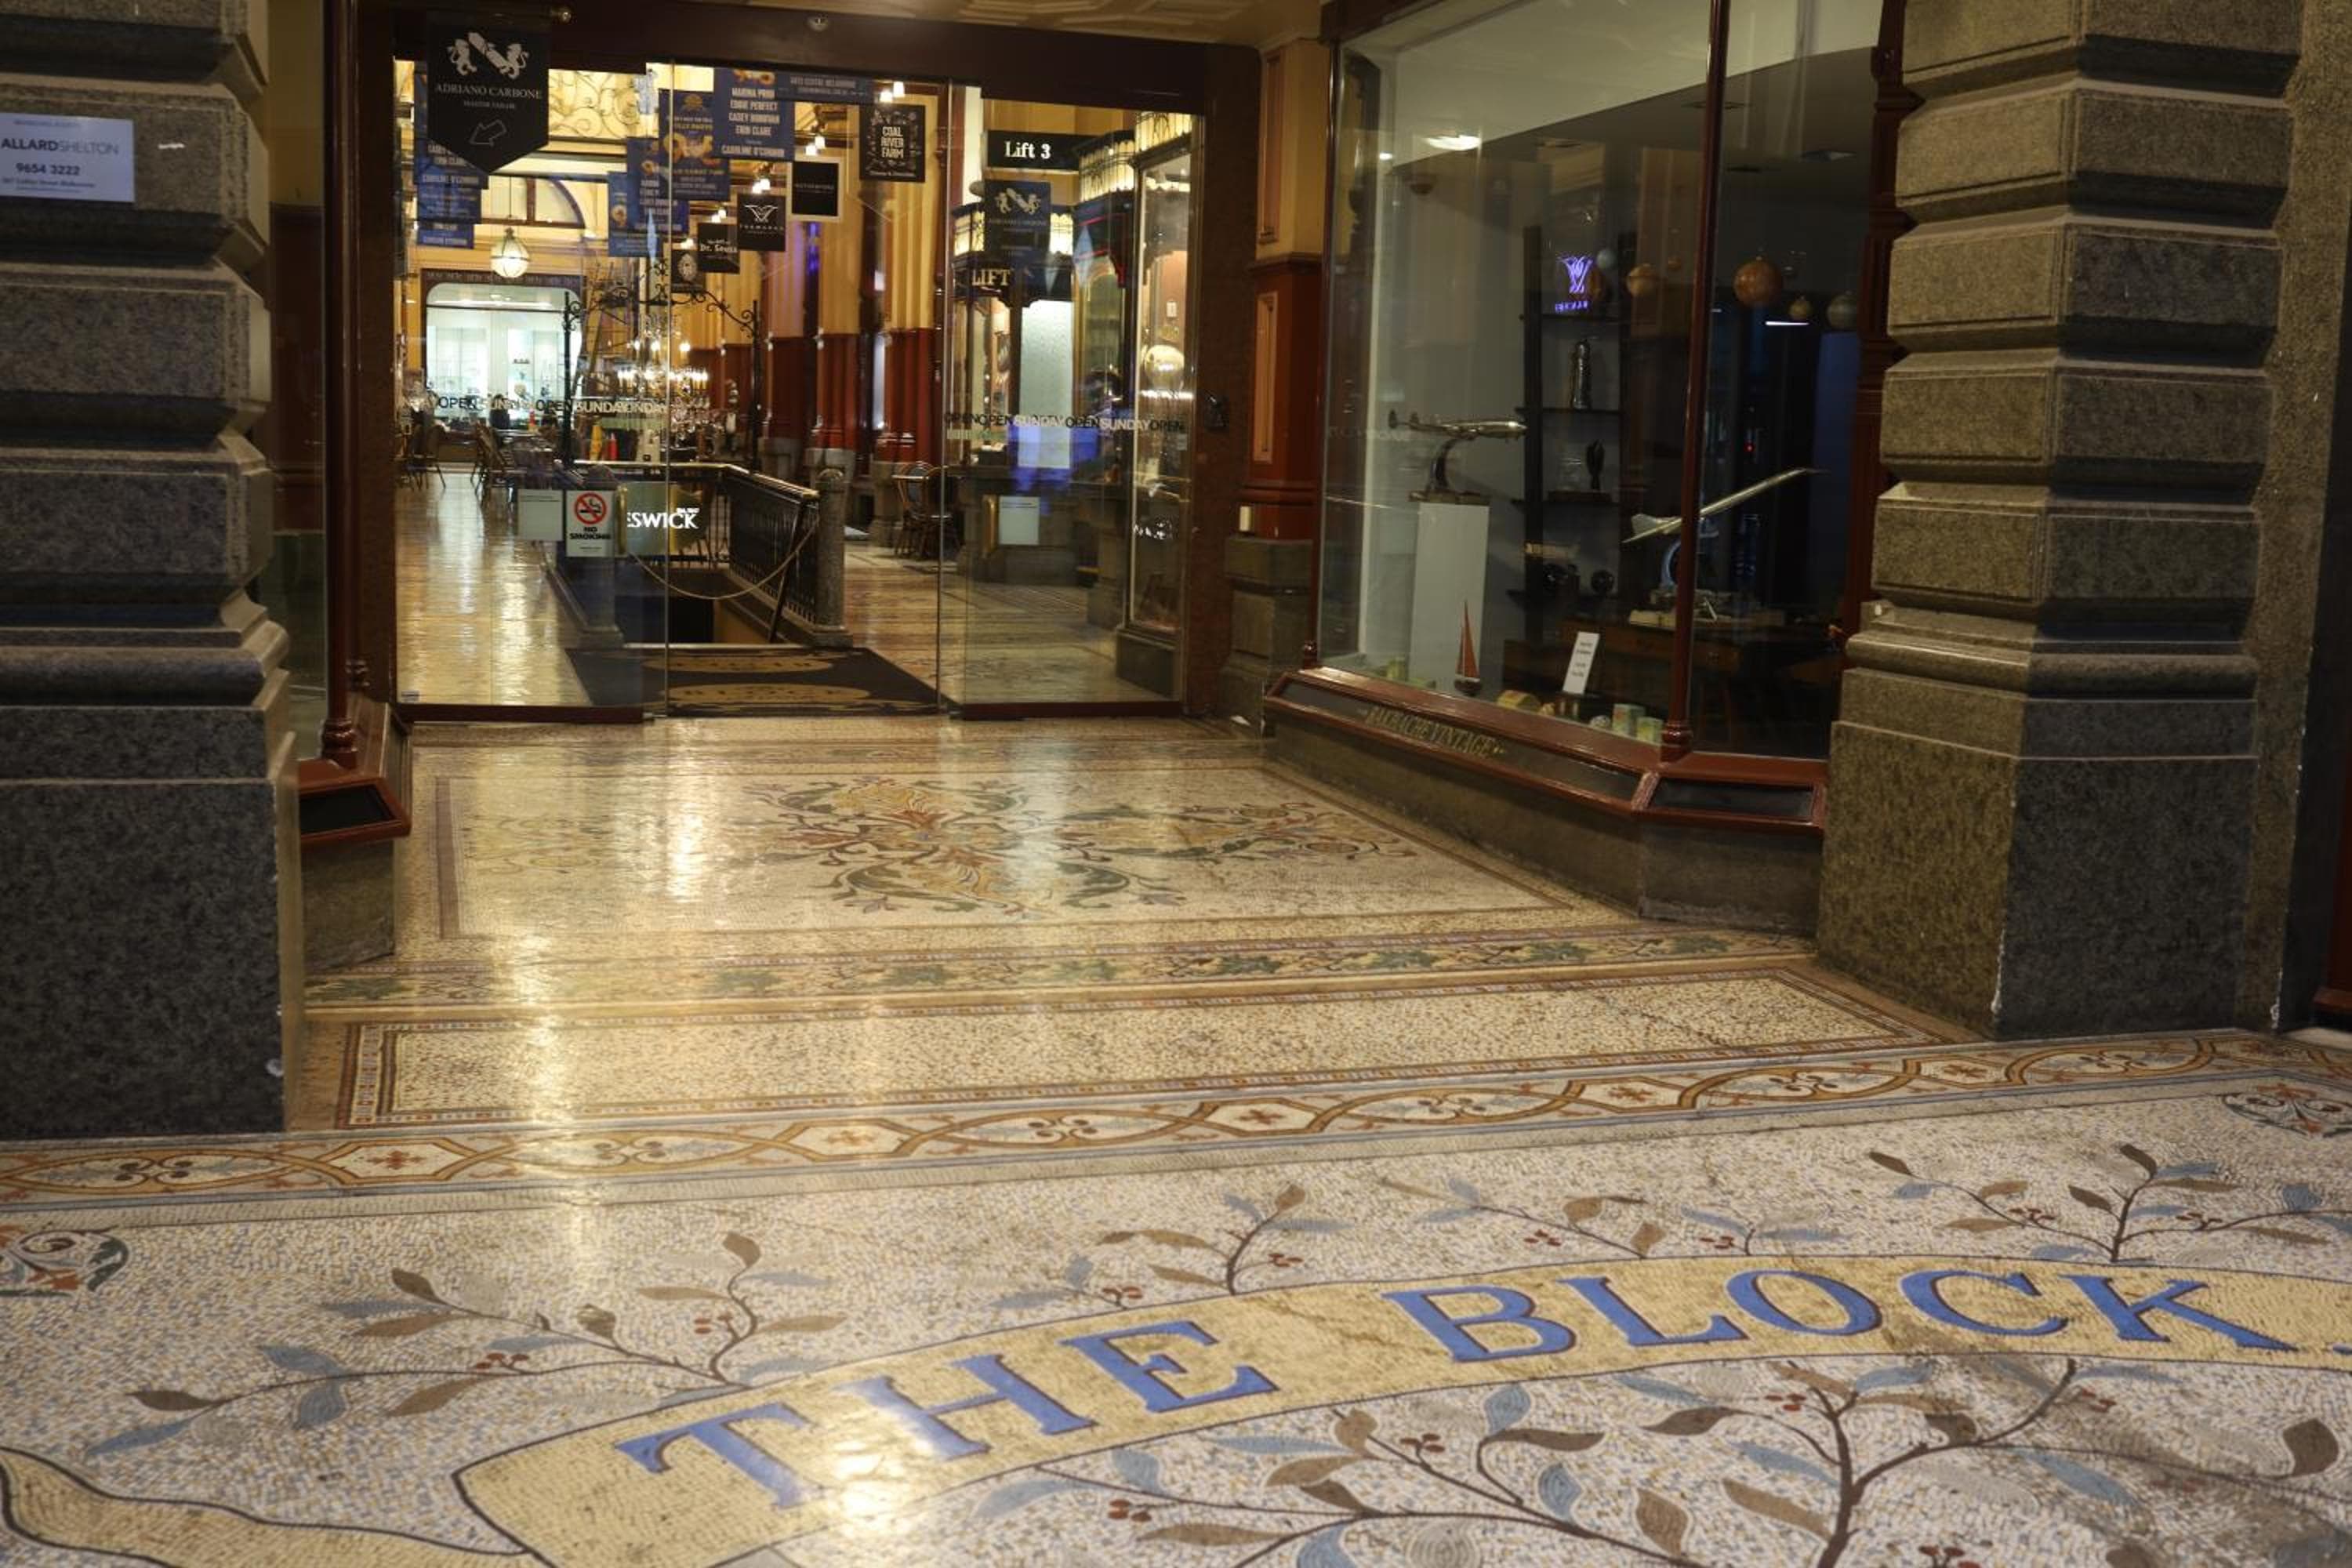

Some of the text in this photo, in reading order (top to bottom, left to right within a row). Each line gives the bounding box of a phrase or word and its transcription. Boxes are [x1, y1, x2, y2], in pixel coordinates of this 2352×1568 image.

[437, 83, 542, 100] ADRIANO CARBONE
[882, 126, 903, 137] COAL
[1004, 140, 1051, 159] Lift 3
[971, 269, 1011, 287] LIFT
[1100, 418, 1151, 430] SUNDAY
[614, 1269, 2299, 1508] THE BLOCK
